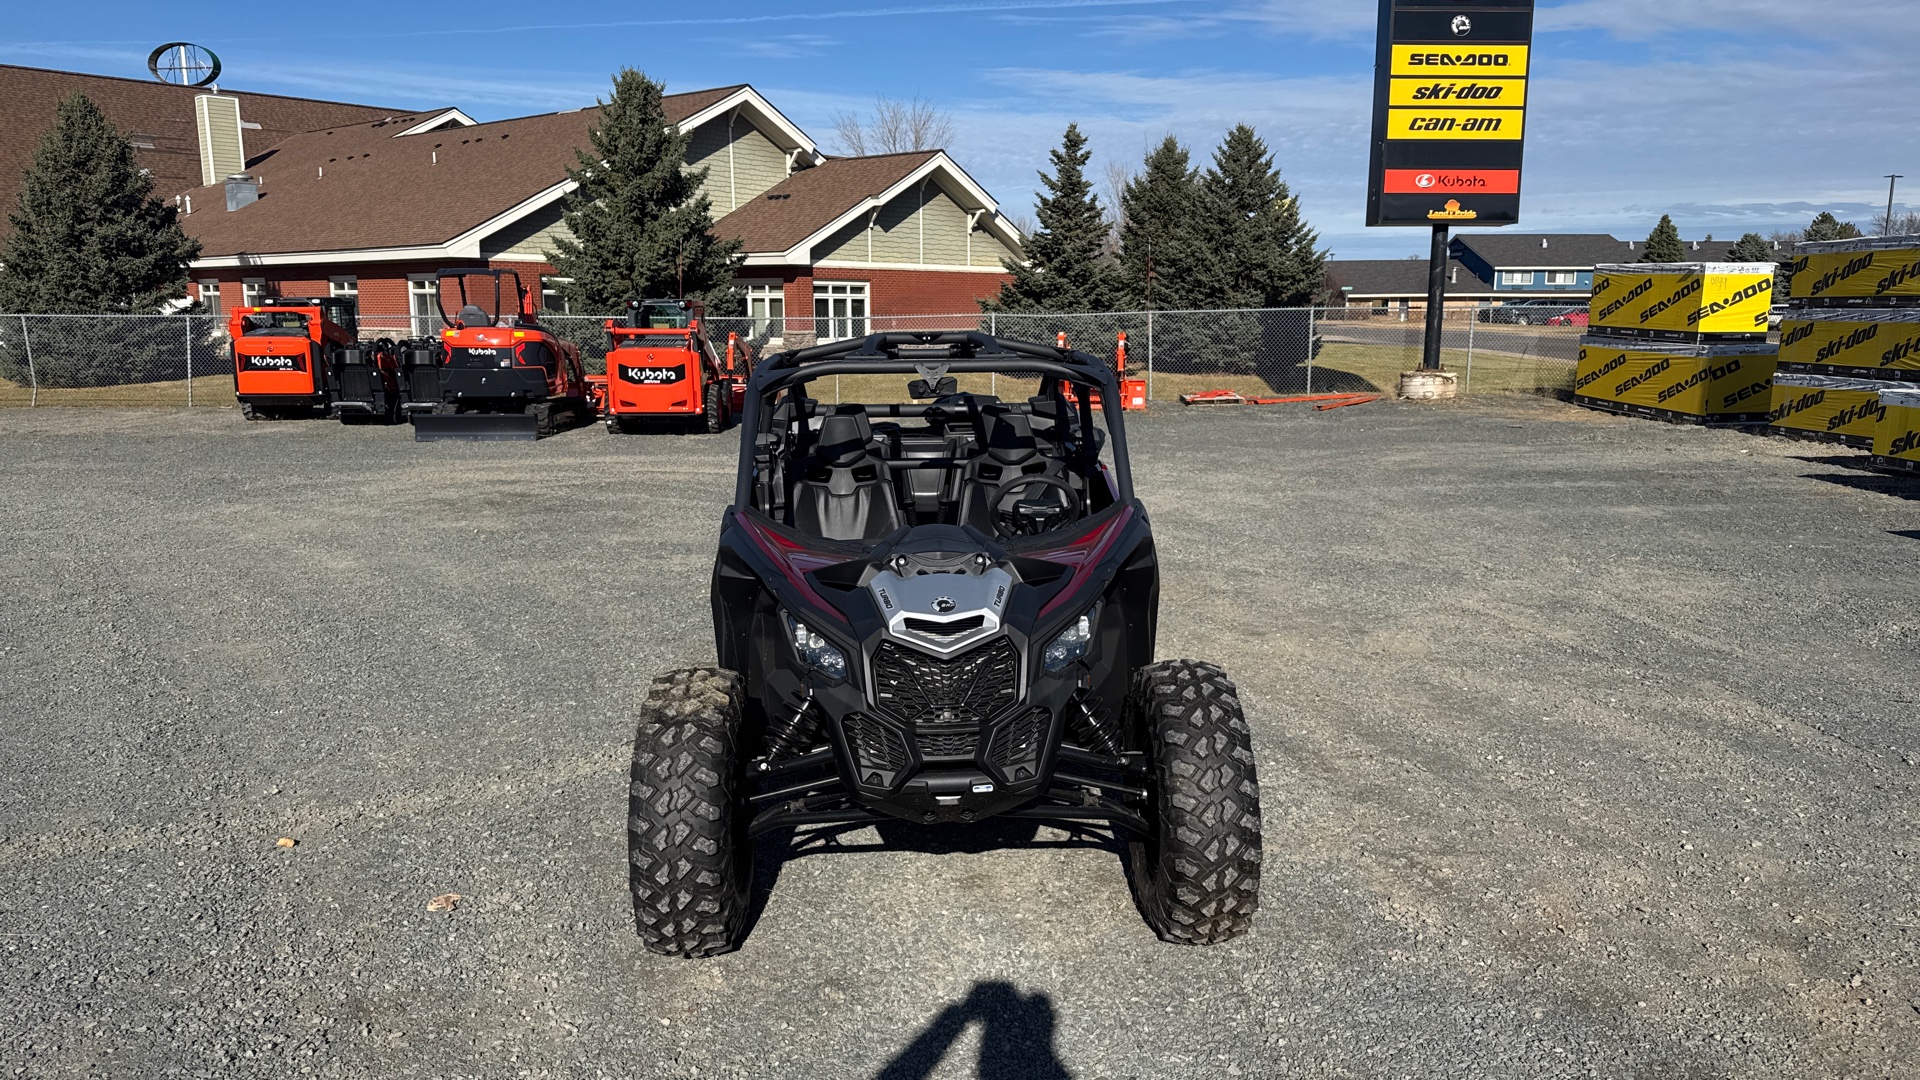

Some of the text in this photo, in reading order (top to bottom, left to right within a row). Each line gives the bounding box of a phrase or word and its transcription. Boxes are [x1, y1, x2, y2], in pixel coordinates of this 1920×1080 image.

[1412, 83, 1503, 100] ski-doo
[1409, 117, 1502, 131] can-am
[1438, 175, 1486, 187] Kubota
[1428, 209, 1477, 217] Land Pride
[1811, 252, 1874, 296] ski-doo
[1816, 324, 1879, 362] ski-doo
[468, 348, 497, 356] Kubota
[251, 356, 293, 366] Kubota
[628, 368, 676, 380] Kubota
[1769, 389, 1825, 424] ski-doo
[878, 587, 894, 610] TURBO
[993, 585, 1006, 608] TURBO
